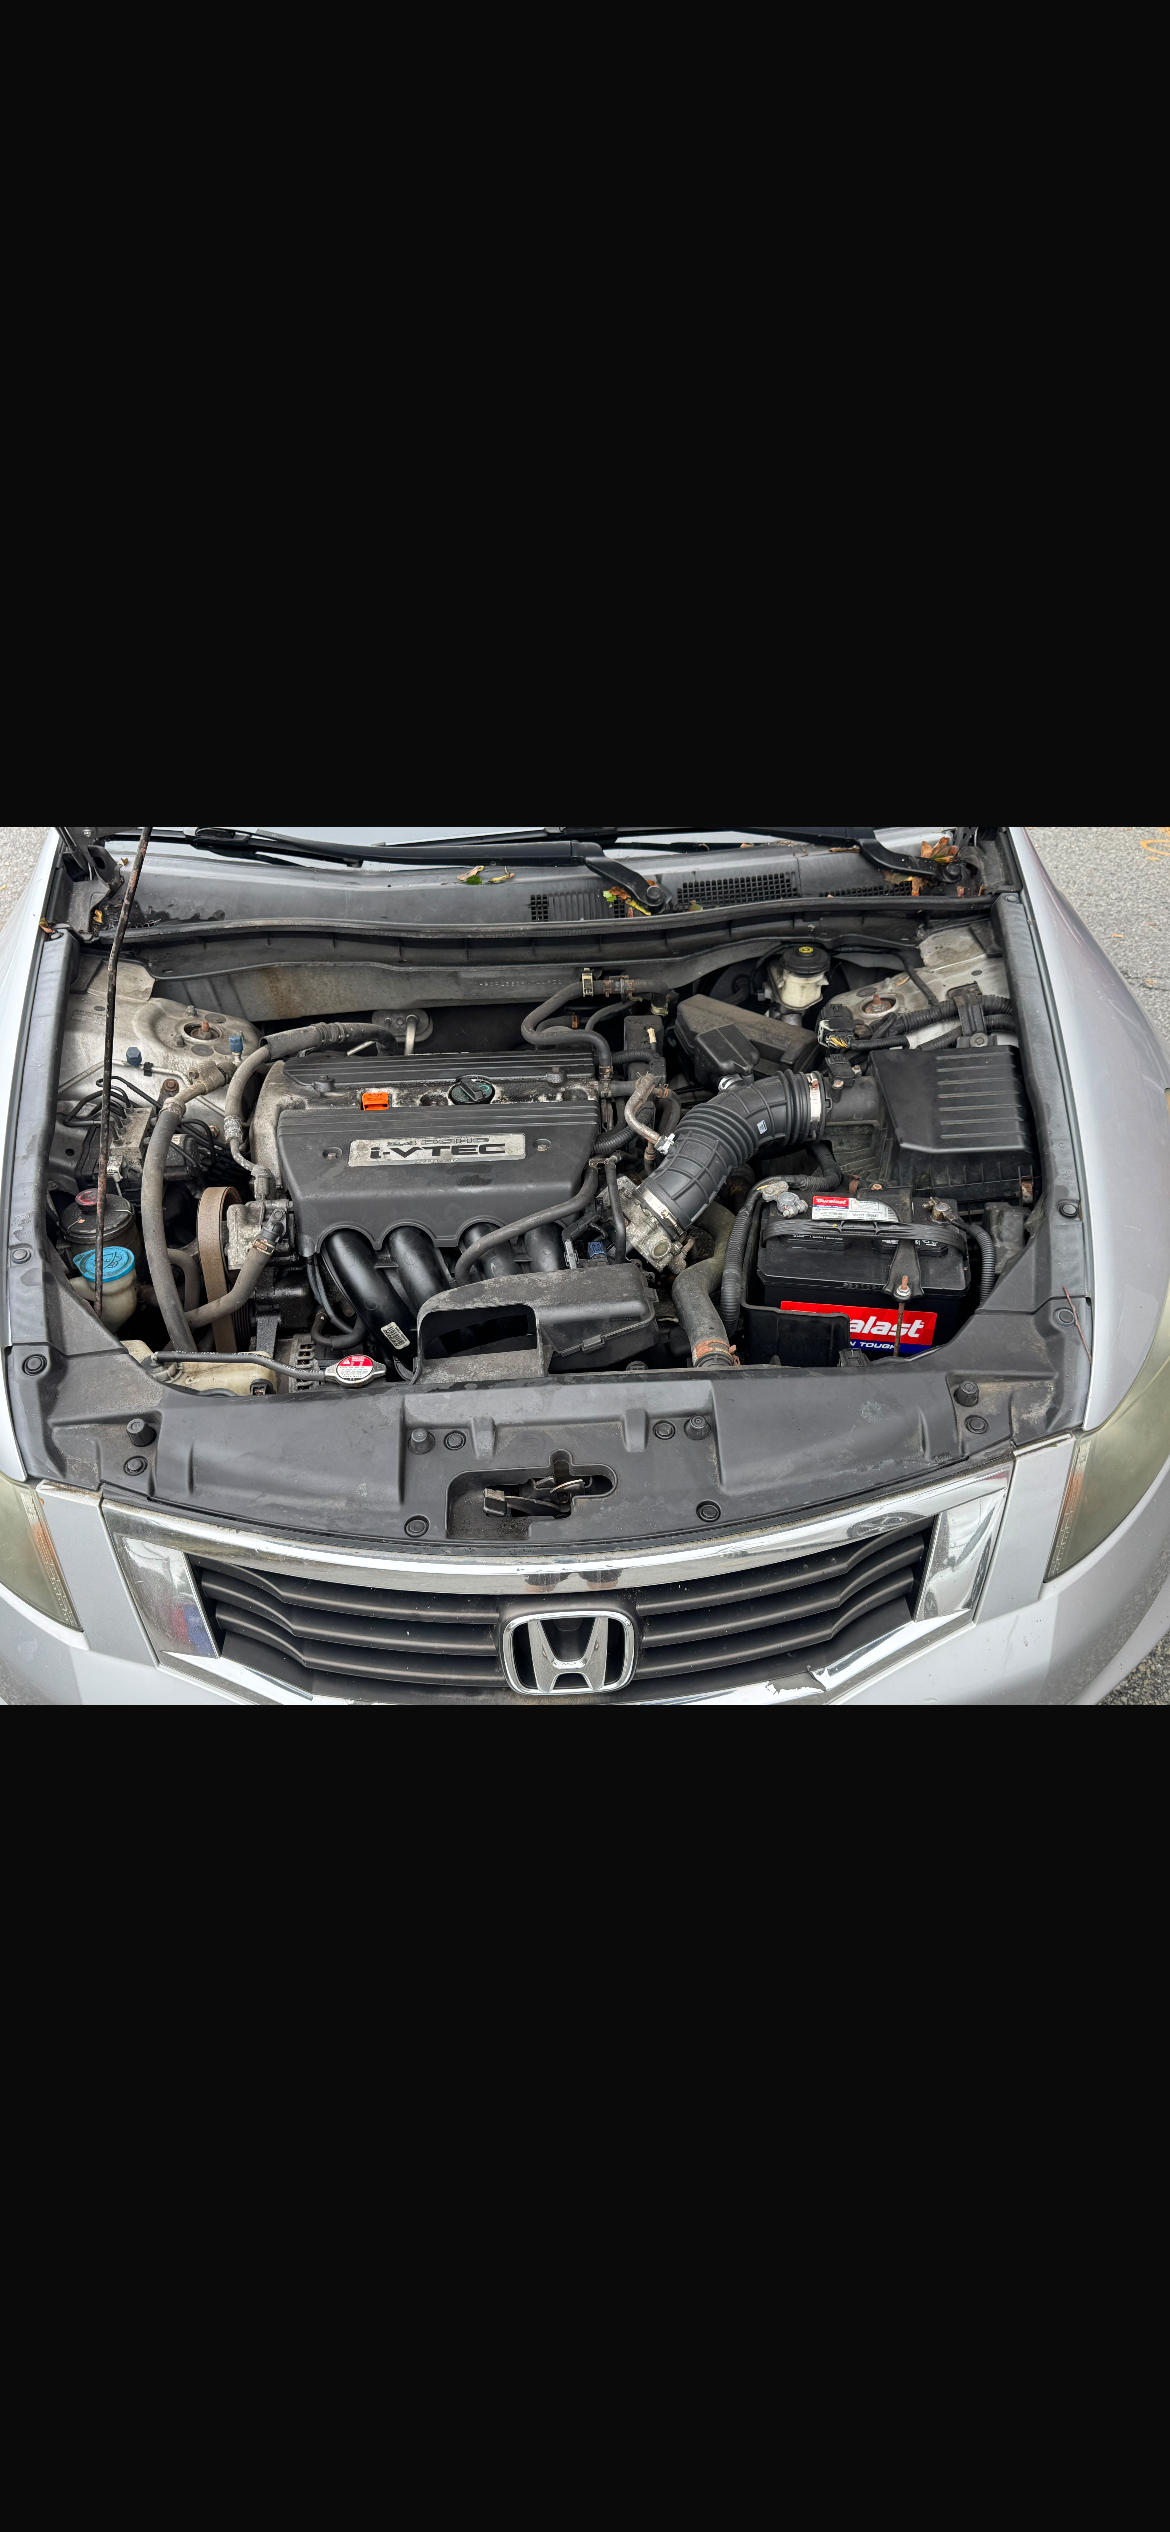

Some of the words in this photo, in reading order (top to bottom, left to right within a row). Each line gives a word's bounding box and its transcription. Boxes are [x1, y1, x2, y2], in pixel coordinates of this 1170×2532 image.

[370, 1143, 506, 1159] i-VTEC
[816, 1197, 847, 1205] Duralast
[850, 1316, 925, 1338] alast
